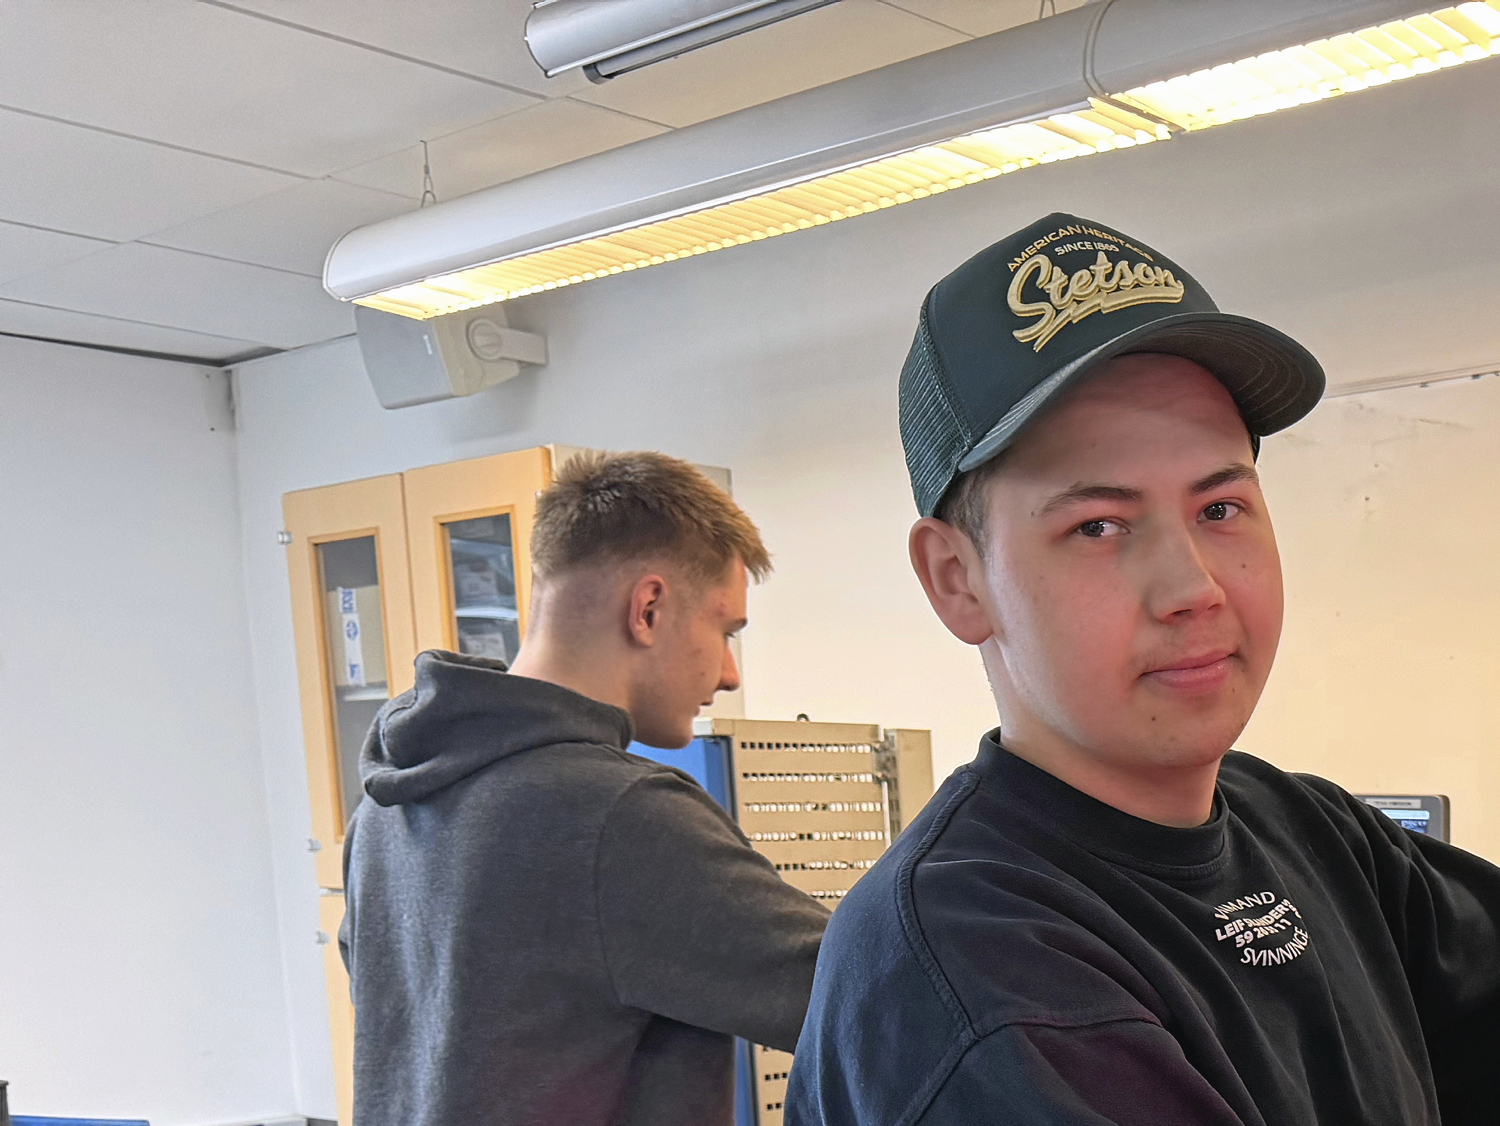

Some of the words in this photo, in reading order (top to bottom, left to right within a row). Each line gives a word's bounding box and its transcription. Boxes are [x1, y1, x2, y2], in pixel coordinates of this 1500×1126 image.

[1007, 224, 1083, 272] AMERICAN
[1054, 240, 1094, 256] SINCE
[1007, 250, 1185, 353] Stetson
[1215, 919, 1246, 941] LEIF
[1235, 930, 1254, 948] 59
[1240, 925, 1309, 967] SVINNINGE
